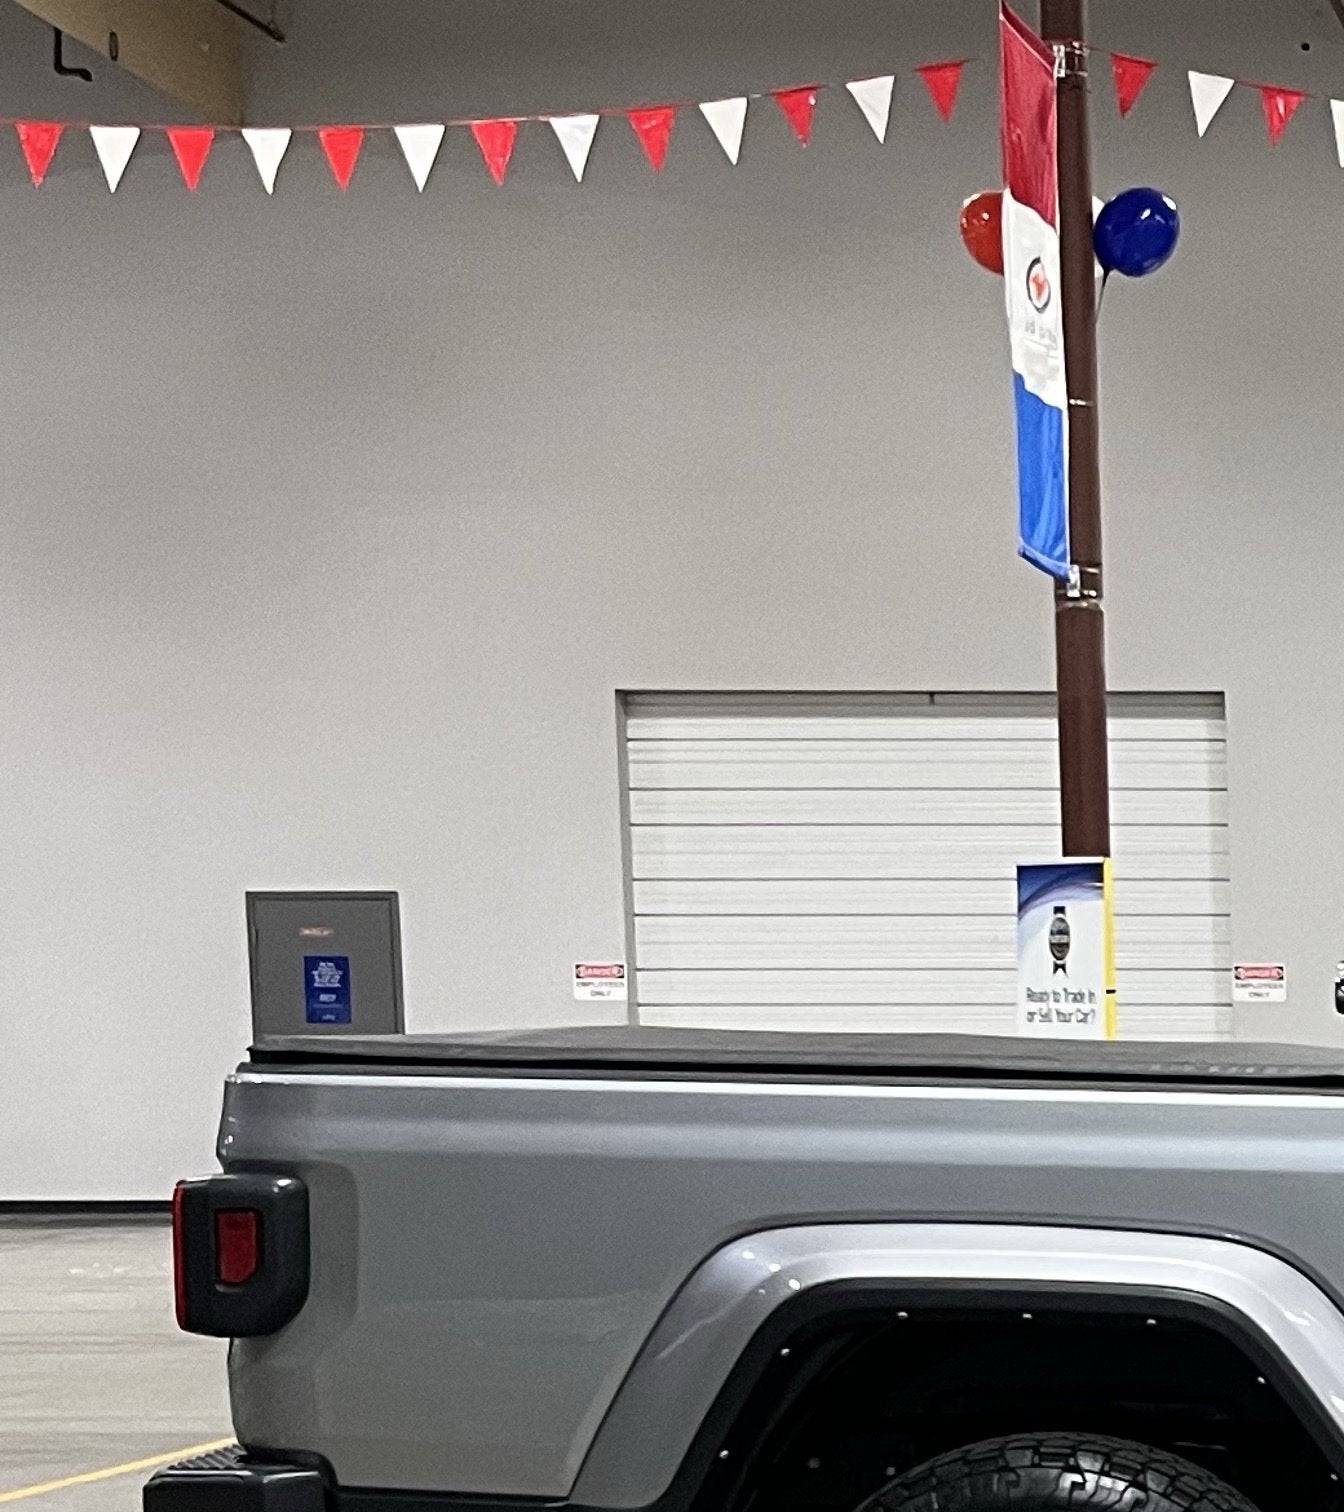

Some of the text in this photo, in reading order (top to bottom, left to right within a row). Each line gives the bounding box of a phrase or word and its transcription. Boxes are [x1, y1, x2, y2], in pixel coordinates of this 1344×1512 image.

[1026, 987, 1050, 1006] Ready
[1052, 989, 1061, 1003] to
[1063, 987, 1086, 1003] Trade
[1027, 1011, 1037, 1023] or
[1038, 1008, 1053, 1023] Sell
[1055, 1008, 1074, 1023] Your
